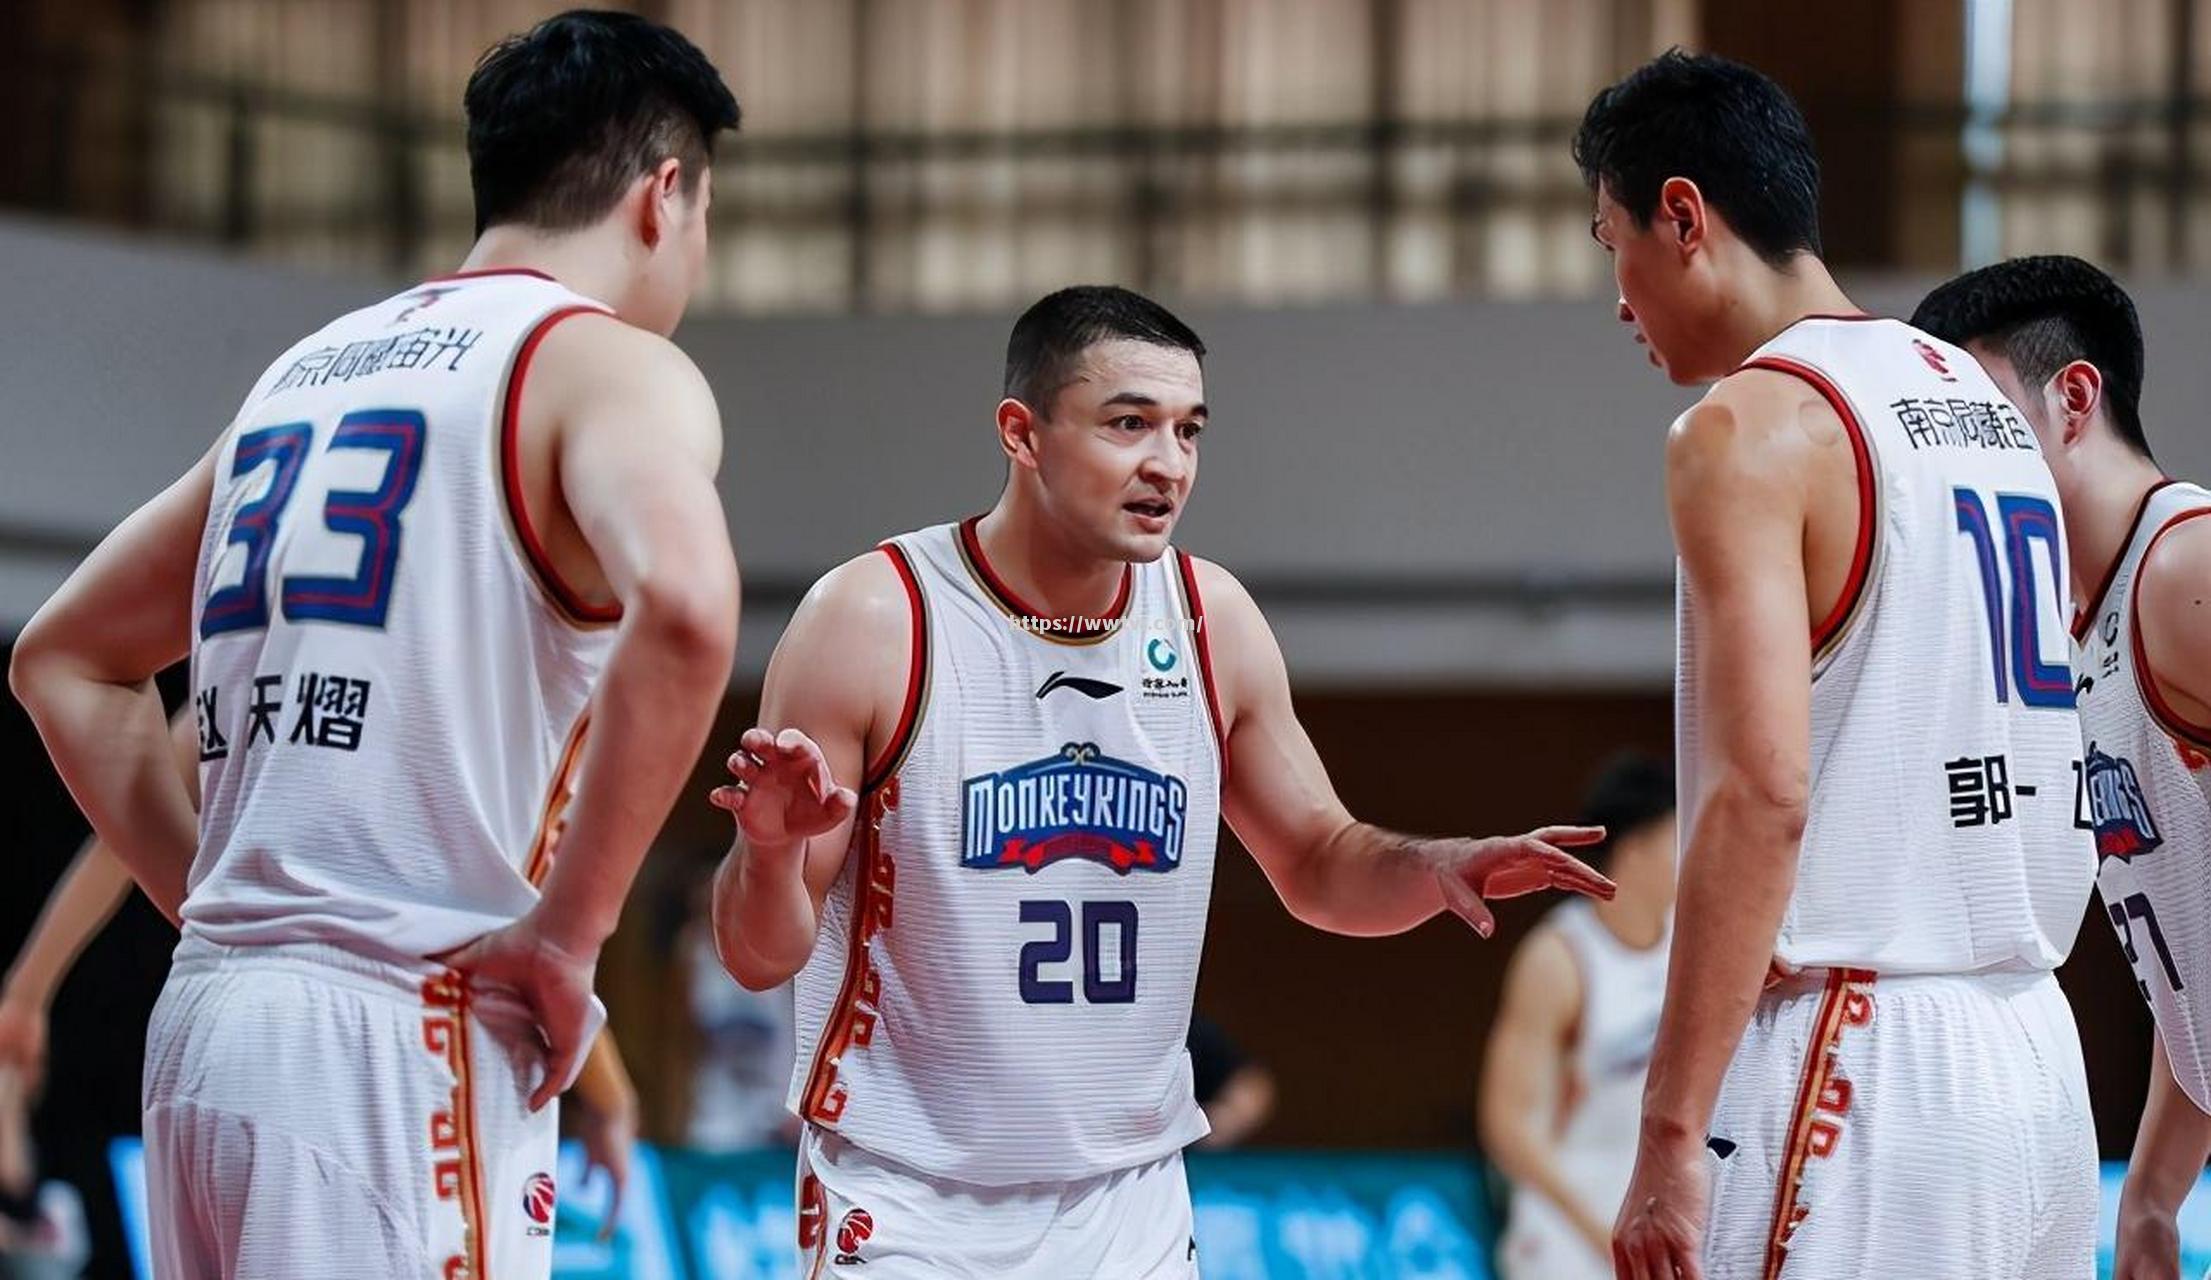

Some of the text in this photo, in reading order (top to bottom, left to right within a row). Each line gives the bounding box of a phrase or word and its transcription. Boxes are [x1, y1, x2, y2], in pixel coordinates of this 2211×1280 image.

[200, 408, 425, 641] 33
[1953, 487, 2076, 709] 10
[1018, 901, 1138, 1004] 20
